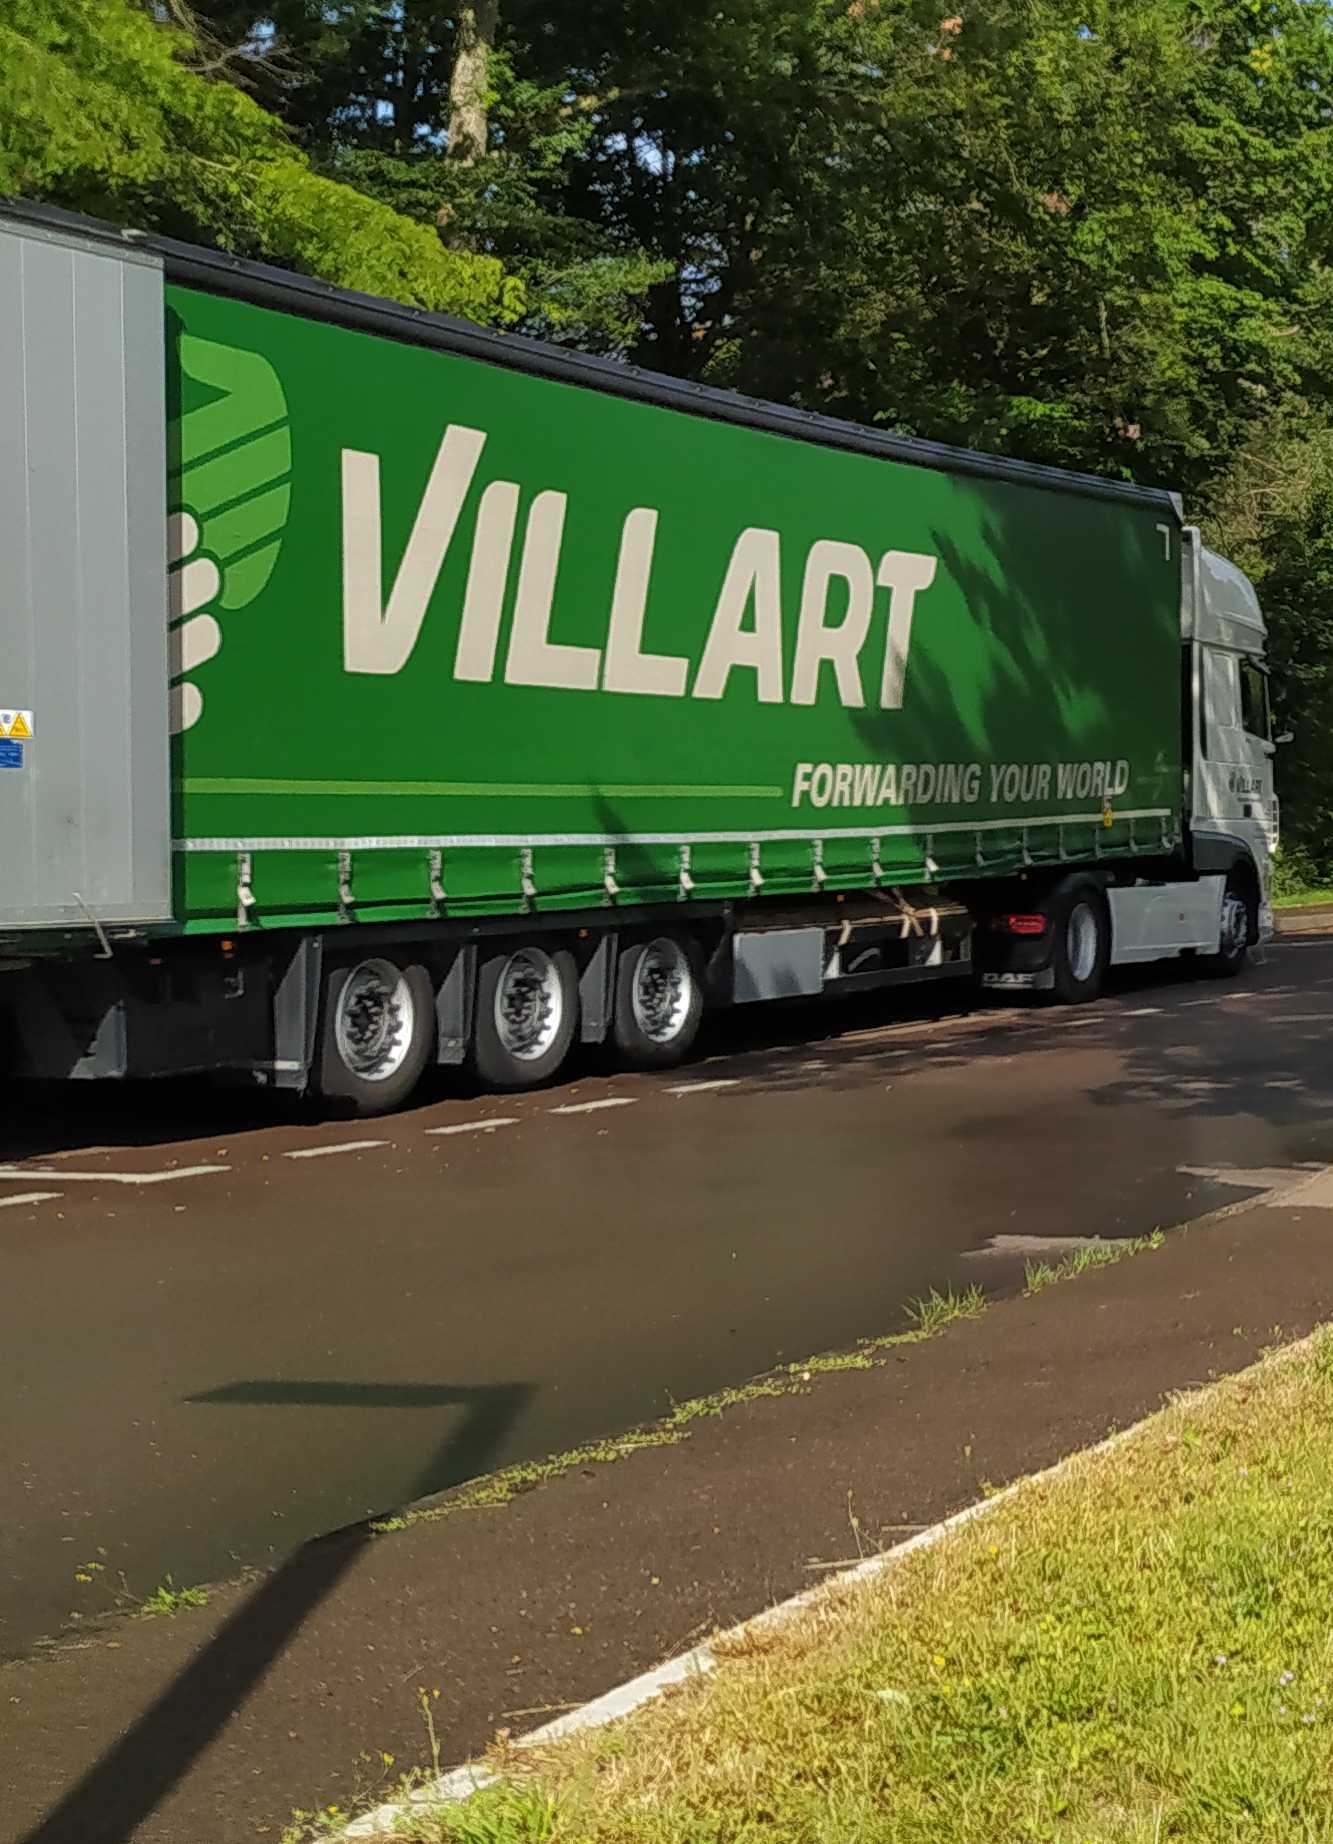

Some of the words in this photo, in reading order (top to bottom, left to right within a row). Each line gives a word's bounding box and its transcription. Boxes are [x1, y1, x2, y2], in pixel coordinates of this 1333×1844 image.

[340, 423, 938, 710] VILLART
[791, 762, 981, 808] FORWARDING
[989, 763, 1052, 803] YOUR
[1056, 759, 1131, 801] WORLD
